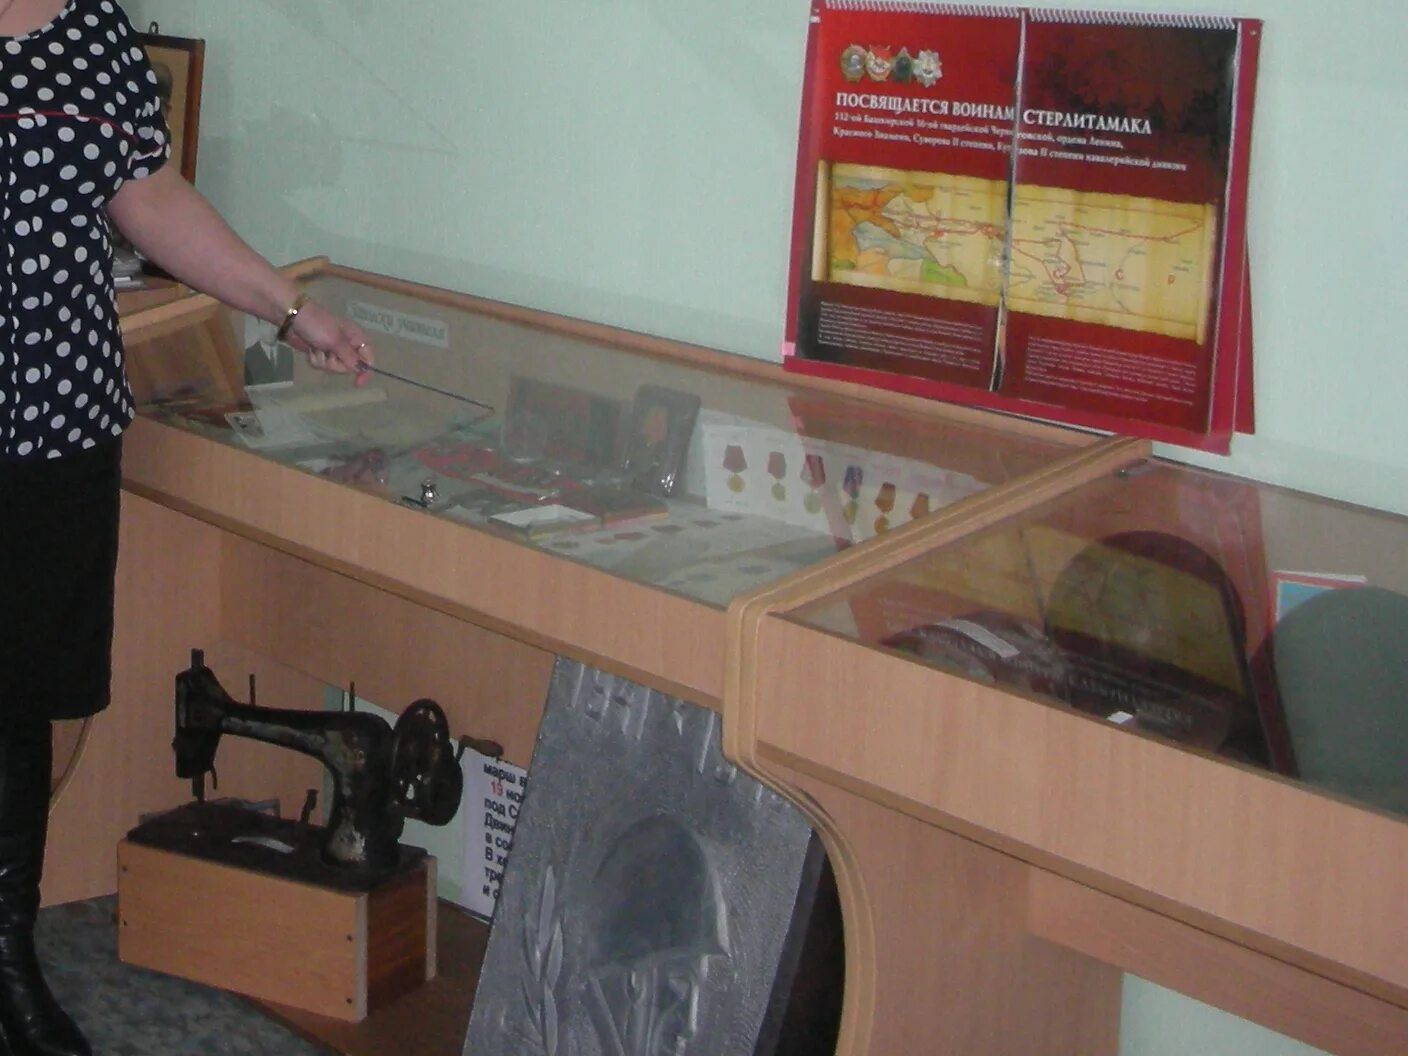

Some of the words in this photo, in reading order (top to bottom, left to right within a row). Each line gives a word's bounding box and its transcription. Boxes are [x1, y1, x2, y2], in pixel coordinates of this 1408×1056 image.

[835, 92, 949, 115] ПОСВЯЩАЕТСЯ
[952, 101, 1015, 121] ВОИНАМ
[1022, 108, 1153, 134] СТЕРЛИТАМАКА
[483, 763, 516, 784] марш
[490, 781, 503, 797] 19
[506, 789, 525, 804] но
[484, 797, 506, 818] под
[495, 837, 512, 851] со
